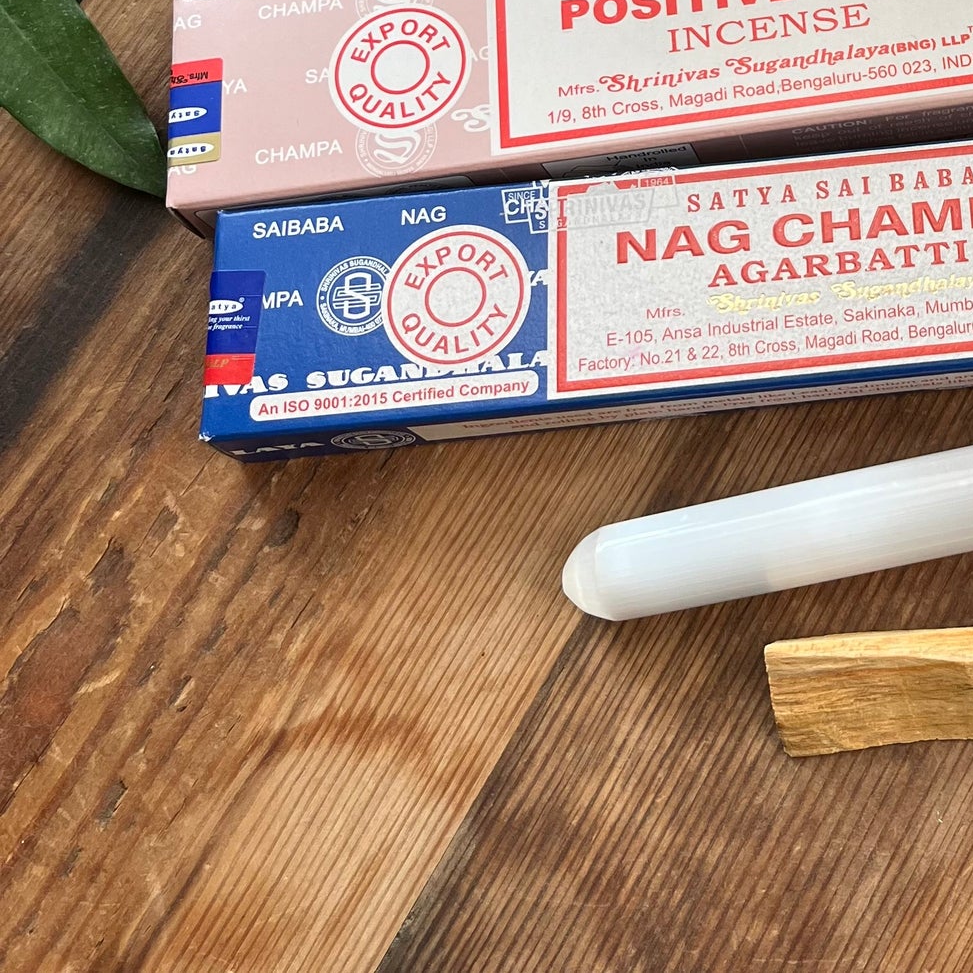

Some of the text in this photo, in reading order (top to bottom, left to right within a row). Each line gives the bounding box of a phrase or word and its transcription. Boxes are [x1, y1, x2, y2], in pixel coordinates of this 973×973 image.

[350, 19, 451, 63] EXPORT
[667, 3, 871, 53] INCENSE
[349, 71, 451, 119] QUALITY
[547, 110, 576, 125] 1/9,
[581, 105, 607, 120] 8th
[612, 99, 663, 115] Cross,
[669, 87, 728, 108] Magadi
[902, 60, 937, 77] 023,
[558, 83, 599, 98] Mfrs.
[598, 67, 720, 93] Shrinivas
[255, 139, 343, 165] CHAMPA
[606, 145, 687, 162] Handrolled
[400, 206, 447, 226] NAG
[687, 184, 797, 213] SATYA
[816, 176, 871, 200] SAI
[252, 215, 345, 239] SAIBABA
[616, 220, 751, 264] NAG
[404, 243, 508, 290] EXPORT
[708, 240, 969, 288] AGARBATTI
[401, 303, 508, 354] QUALITY
[606, 329, 657, 347] E-105,
[662, 327, 702, 341] Ansa
[708, 316, 779, 336] Industrial
[784, 311, 838, 328] Estate,
[844, 303, 920, 322] Sakinaka,
[646, 307, 685, 320] Mfrs.
[578, 354, 635, 373] Factory:
[640, 348, 681, 366] No.21
[687, 347, 698, 362] &
[702, 345, 724, 361] 22,
[728, 341, 750, 357] 8th
[755, 338, 800, 355] Cross,
[805, 331, 857, 350] Magadi
[862, 327, 903, 344] Road,
[258, 378, 530, 416] An ISO 9001:2015 Certified Company
